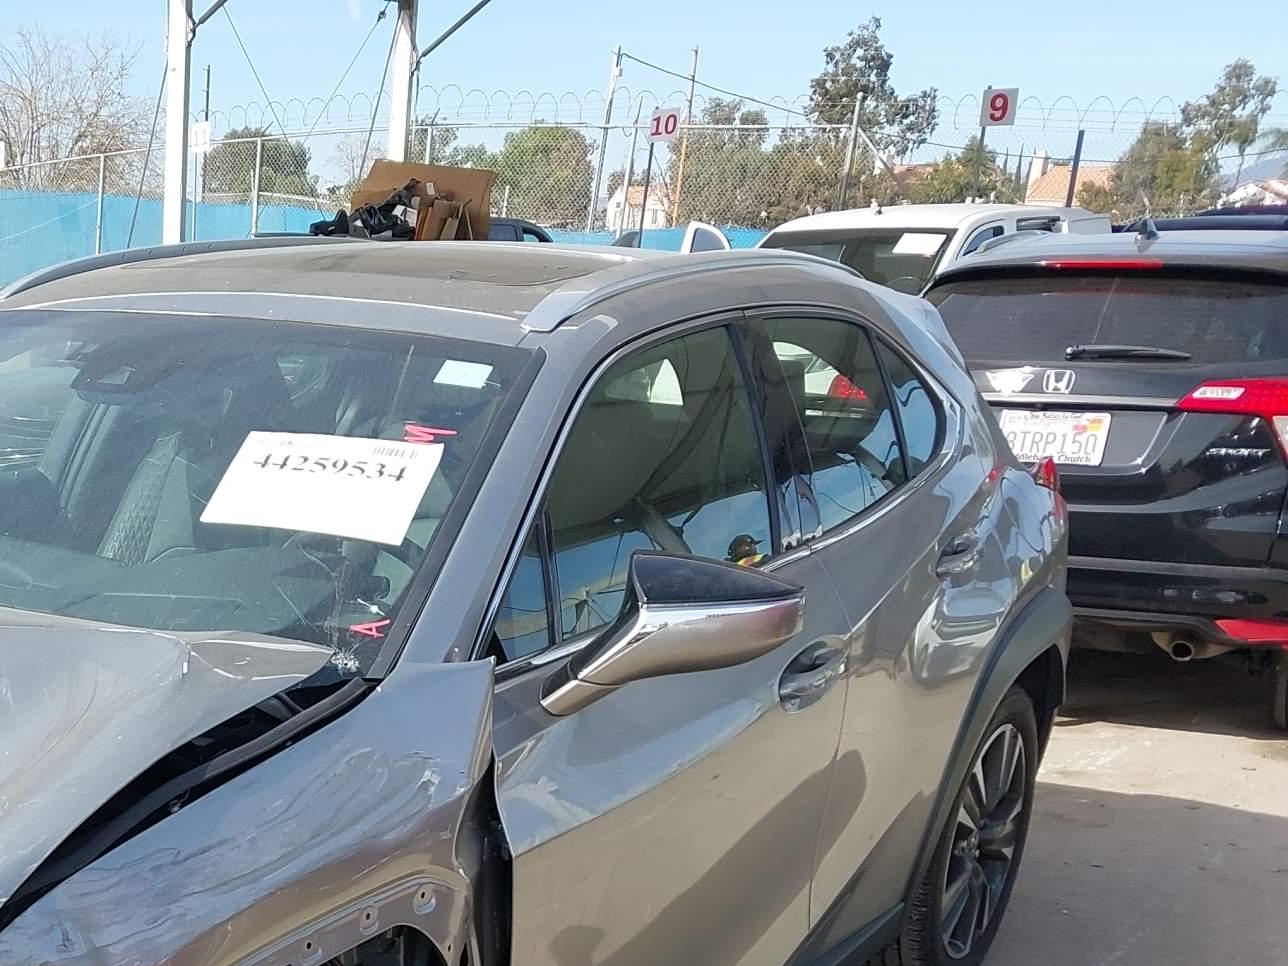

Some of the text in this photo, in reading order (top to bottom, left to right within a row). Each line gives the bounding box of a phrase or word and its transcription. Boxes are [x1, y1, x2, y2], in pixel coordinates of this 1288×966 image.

[990, 93, 1009, 121] 9
[651, 113, 678, 136] 10
[253, 453, 408, 482] 44259534
[1058, 454, 1092, 463] Church
